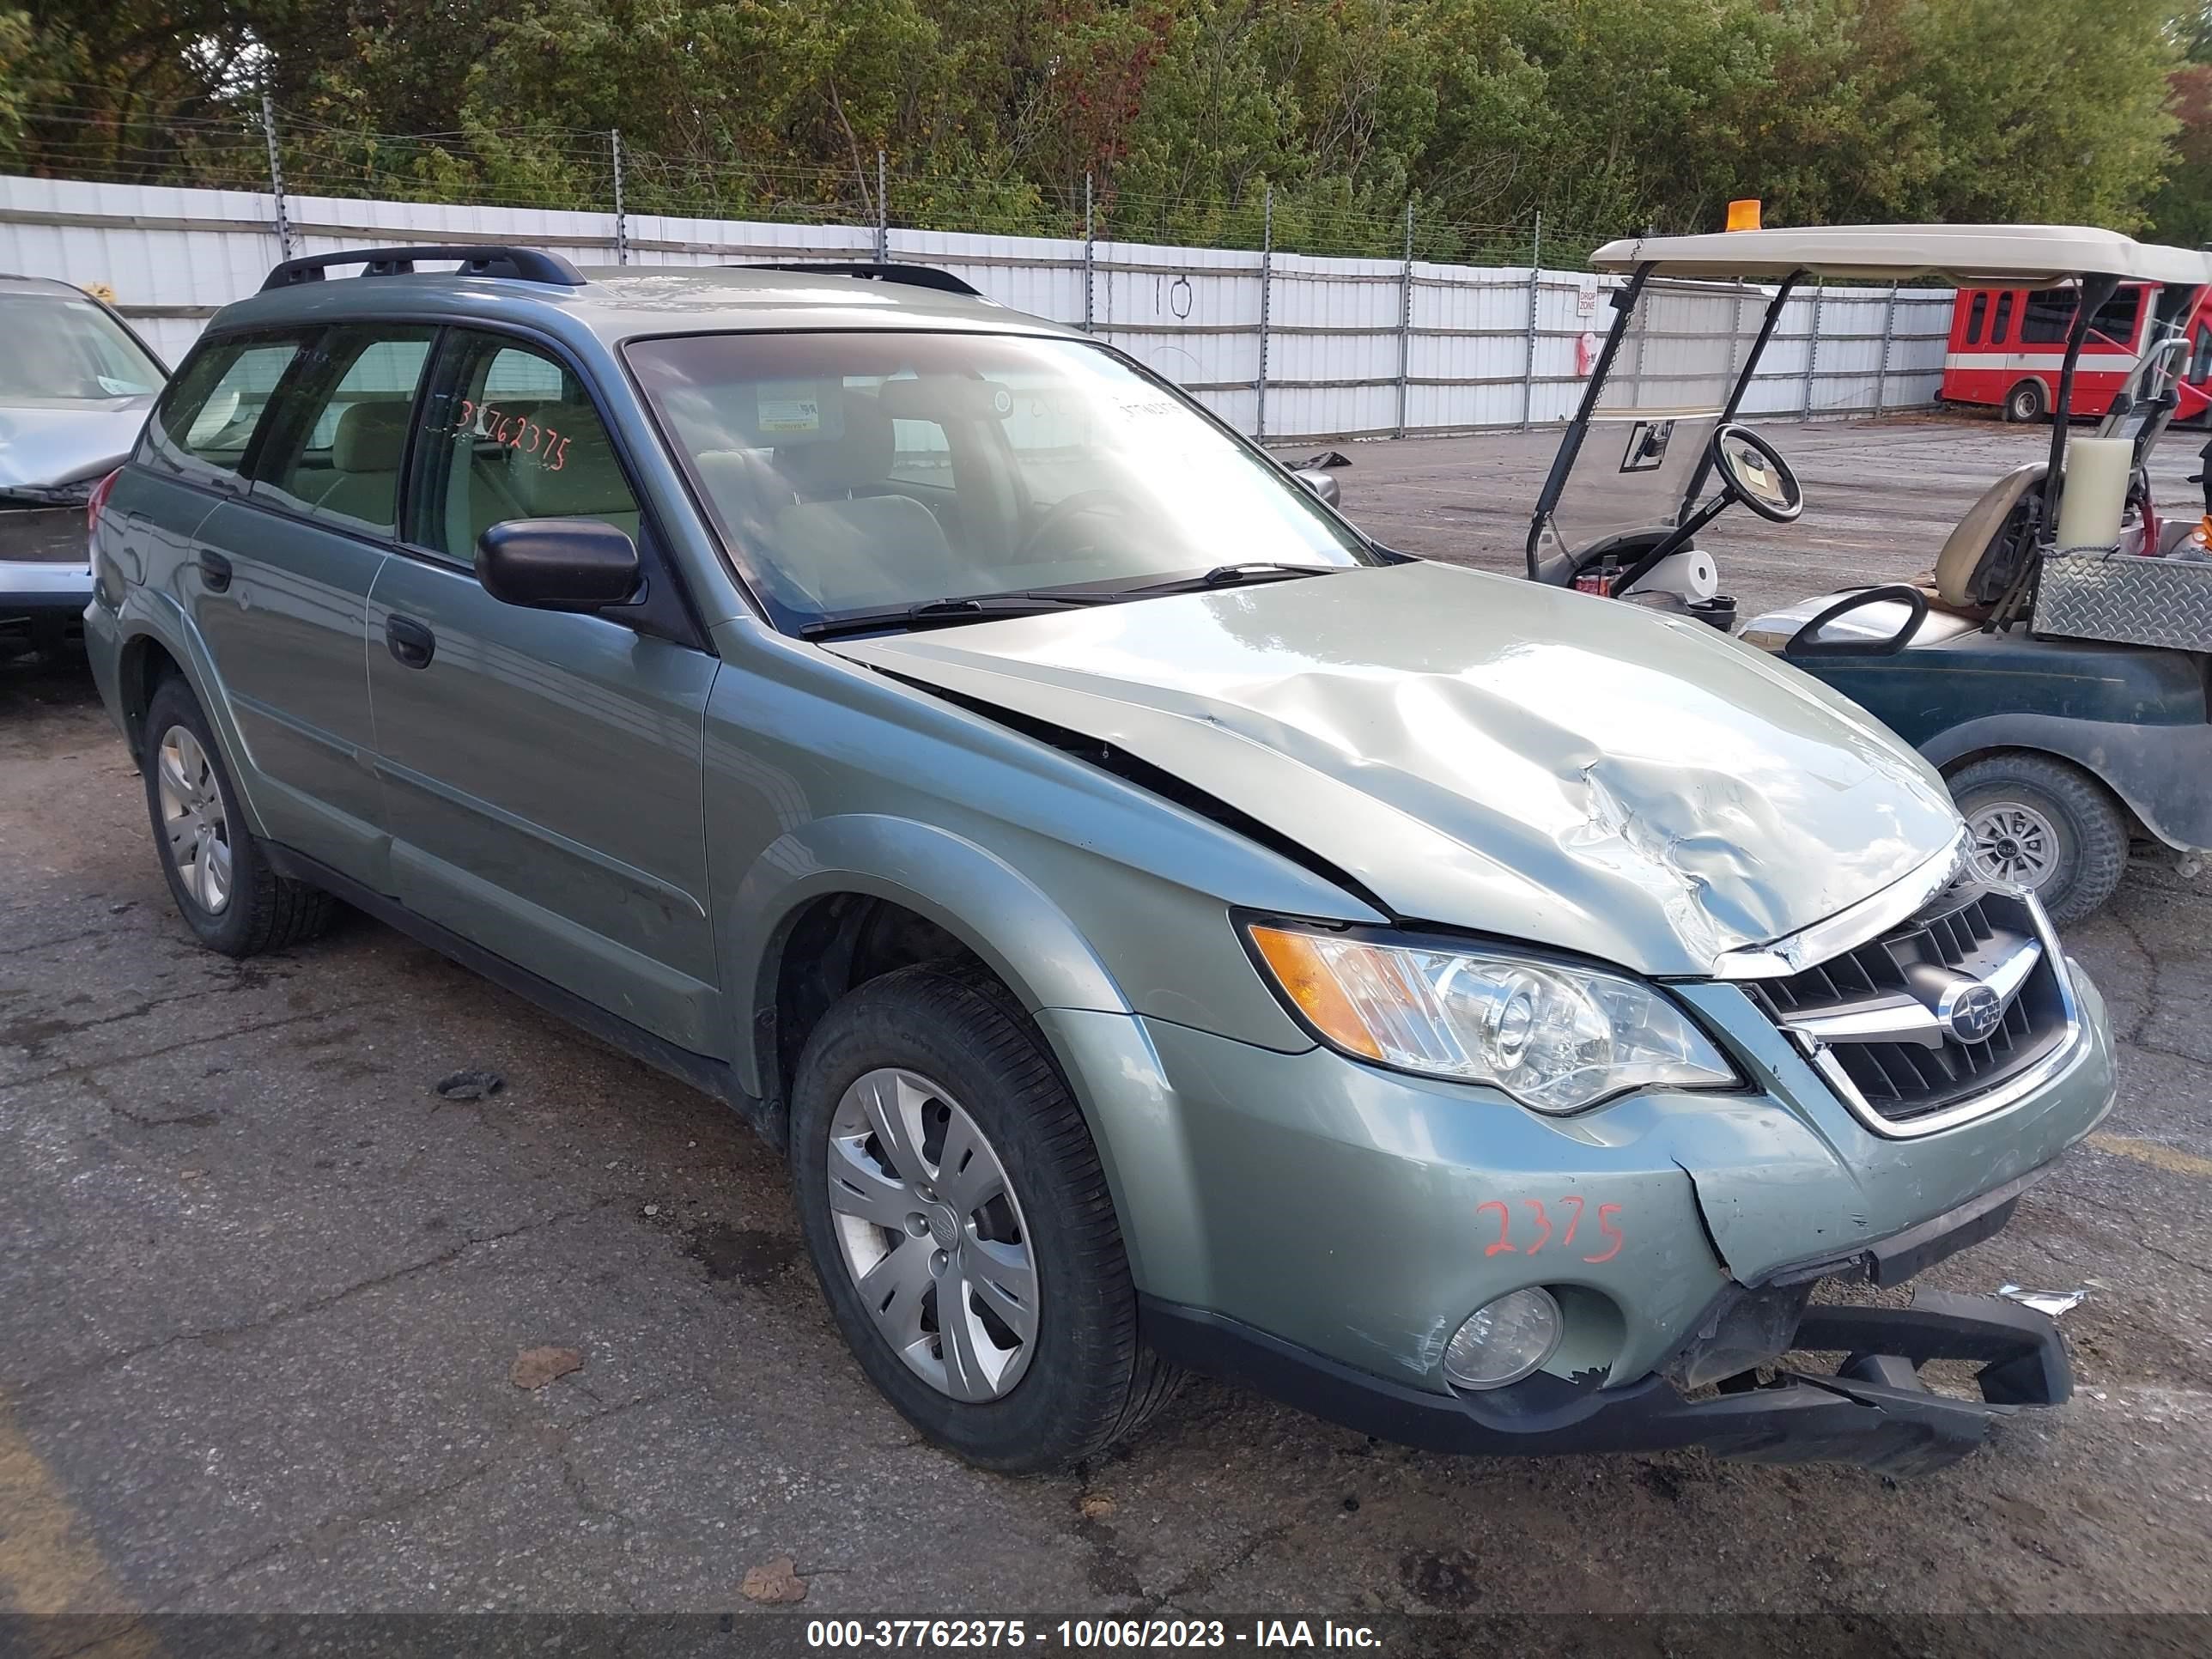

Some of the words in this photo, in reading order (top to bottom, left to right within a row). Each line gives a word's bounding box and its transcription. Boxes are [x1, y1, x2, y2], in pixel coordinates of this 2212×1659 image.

[1156, 276, 1192, 319] 10
[1580, 292, 1596, 301] DROP
[1476, 1196, 1623, 1262] 2375
